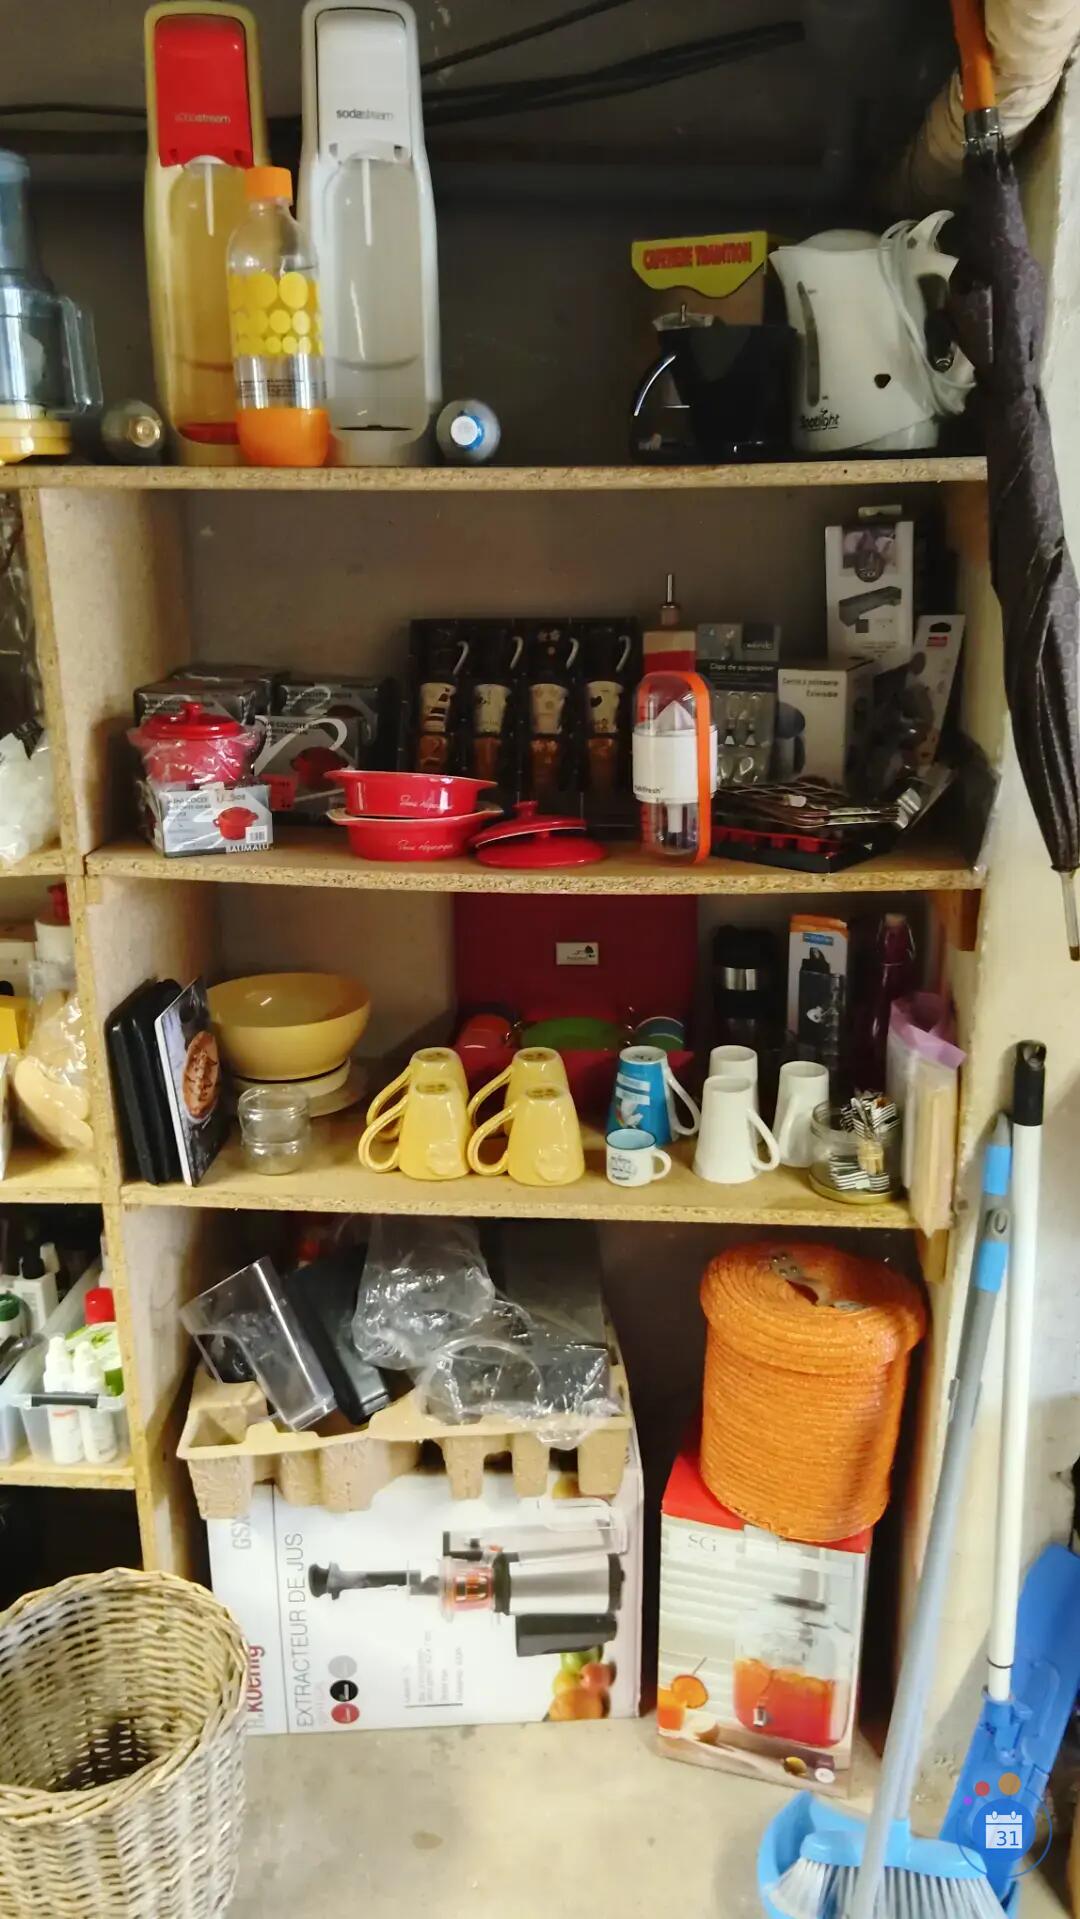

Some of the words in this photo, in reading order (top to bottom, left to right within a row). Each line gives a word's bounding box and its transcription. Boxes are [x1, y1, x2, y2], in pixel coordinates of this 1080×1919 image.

[284, 1533, 305, 1572] JUS
[287, 1577, 306, 1603] DE
[288, 1608, 314, 1728] EXTRACTEUR
